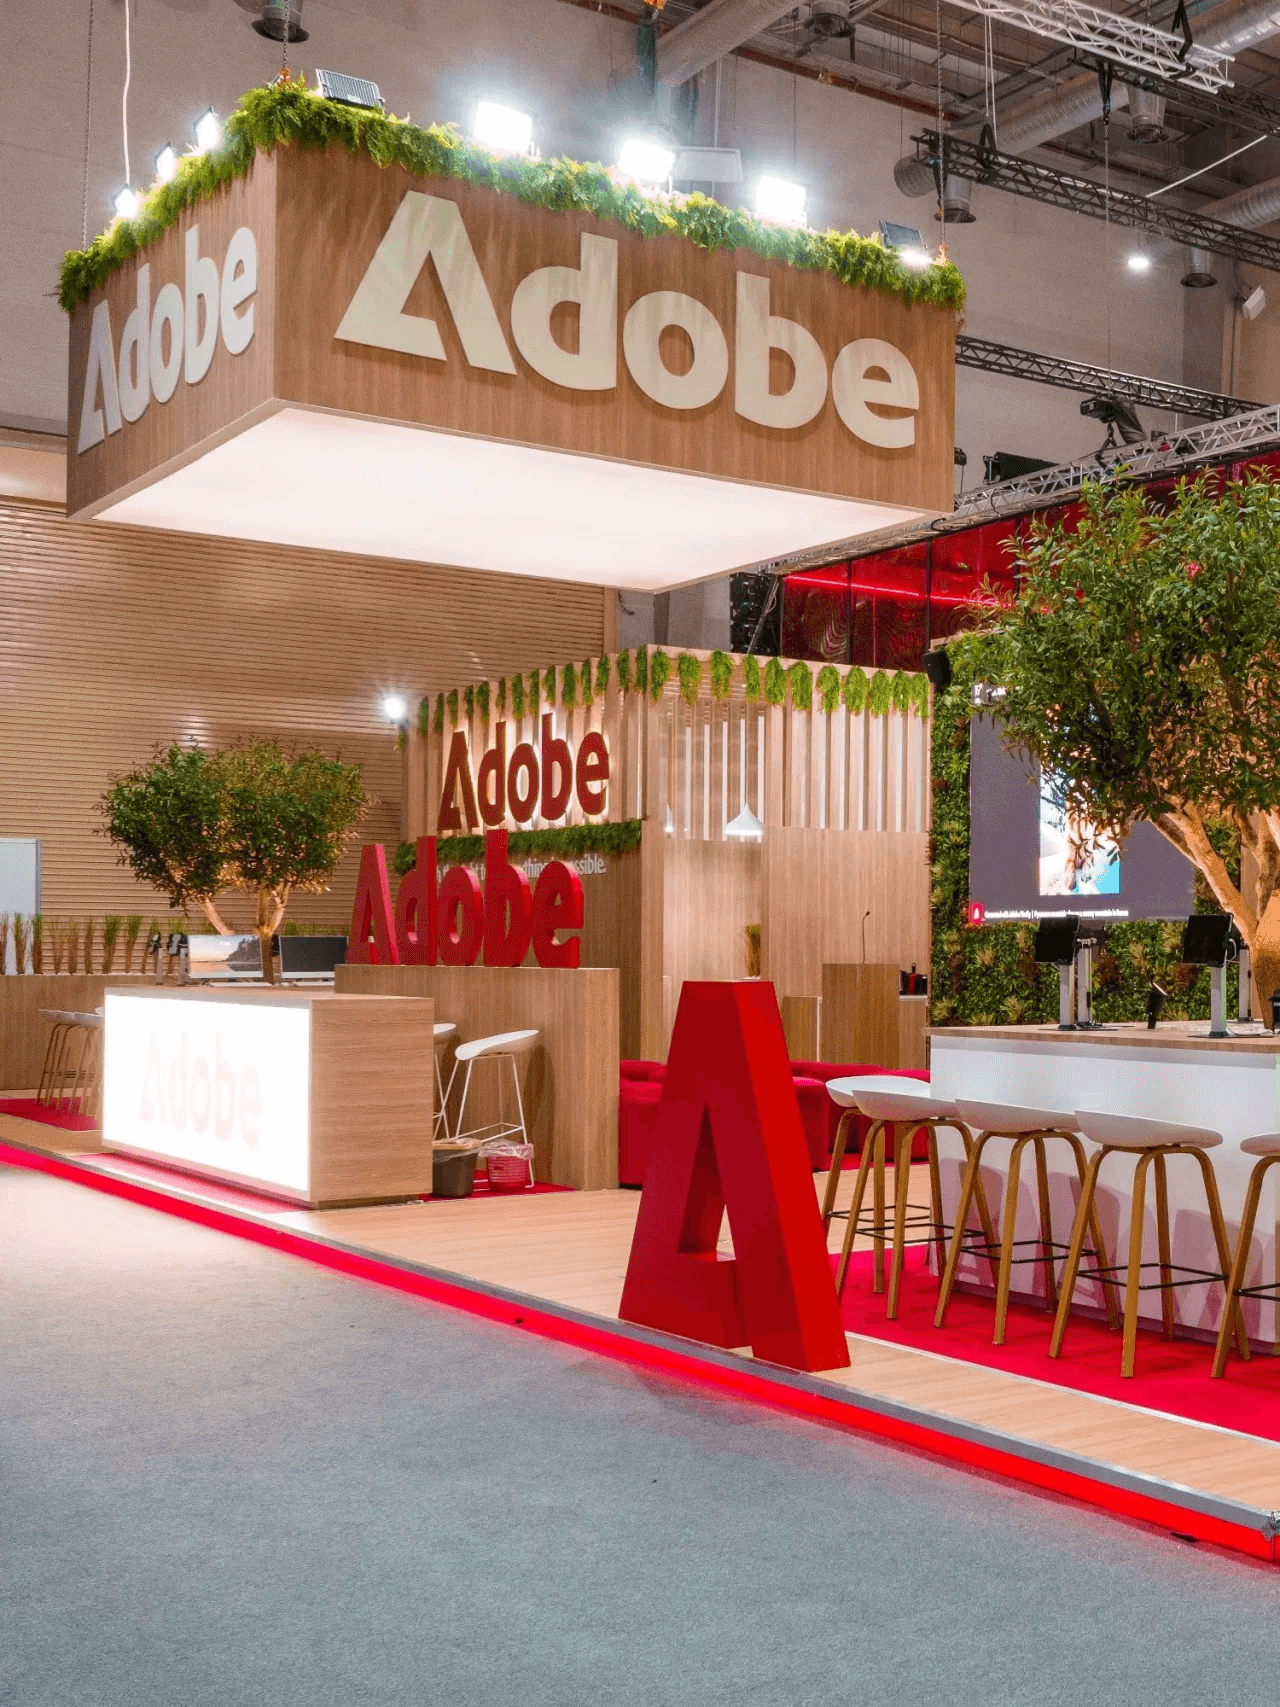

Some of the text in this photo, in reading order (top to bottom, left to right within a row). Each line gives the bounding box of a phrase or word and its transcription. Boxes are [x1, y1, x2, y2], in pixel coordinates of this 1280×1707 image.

[76, 225, 258, 454] Adobe
[334, 190, 920, 449] Adobe
[437, 713, 610, 831] Adobe
[346, 828, 584, 969] Adobe
[139, 1028, 263, 1150] Adobe
